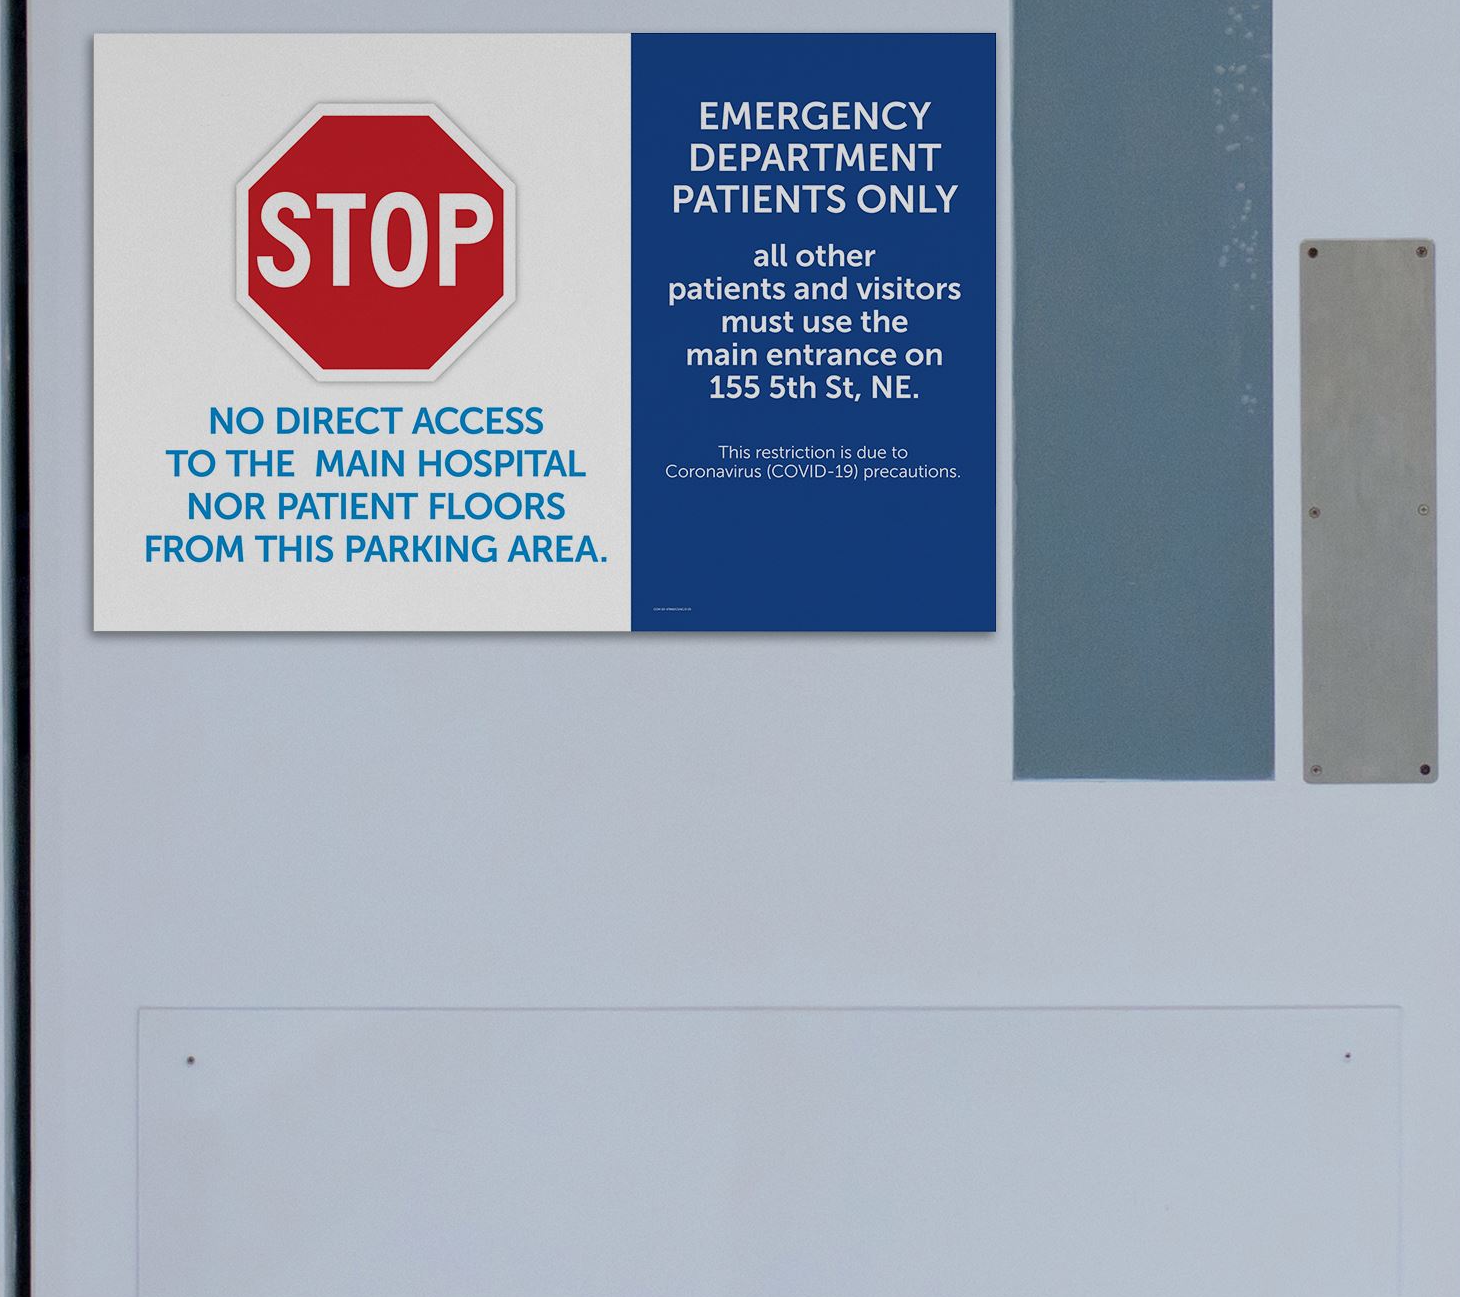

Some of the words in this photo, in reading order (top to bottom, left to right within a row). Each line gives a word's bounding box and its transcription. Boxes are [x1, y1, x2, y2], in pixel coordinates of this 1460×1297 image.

[700, 100, 932, 131] EMERGENCY
[690, 142, 942, 172] DEPARTMENT
[673, 184, 846, 214] PATIENTS
[856, 184, 959, 214] ONLY
[256, 191, 494, 288] STOP
[753, 243, 788, 268] all
[795, 243, 877, 268] other
[668, 276, 786, 307] patients
[793, 276, 848, 301] and
[855, 276, 962, 301] visitors
[721, 310, 794, 334] must
[802, 314, 853, 334] use
[860, 309, 909, 334] the
[686, 341, 758, 367] main
[766, 343, 897, 367] entrance
[904, 347, 943, 367] on
[709, 374, 761, 400] 155
[769, 374, 817, 400] 5th
[825, 374, 862, 402] St,
[871, 374, 919, 399] NE.
[209, 405, 266, 436] NO
[275, 405, 405, 436] DIRECT
[411, 405, 545, 436] ACCESS
[163, 448, 217, 479] TO
[224, 448, 296, 479] THE
[315, 448, 406, 479] MAIN
[417, 448, 587, 479] HOSPITAL
[717, 445, 751, 460] This
[755, 445, 836, 460] restriction
[840, 445, 852, 460] is
[856, 445, 887, 460] due
[891, 446, 909, 460] to
[665, 463, 762, 479] Coronavirus
[766, 463, 859, 480] (COVID-19)
[863, 464, 961, 482] precautions.
[187, 490, 266, 522] NOR
[277, 490, 420, 522] PATIENT
[429, 490, 567, 522] FLOORS
[144, 533, 246, 564] FROM
[253, 533, 335, 564] THIS
[344, 533, 499, 564] PARKING
[506, 533, 609, 564] AREA.
